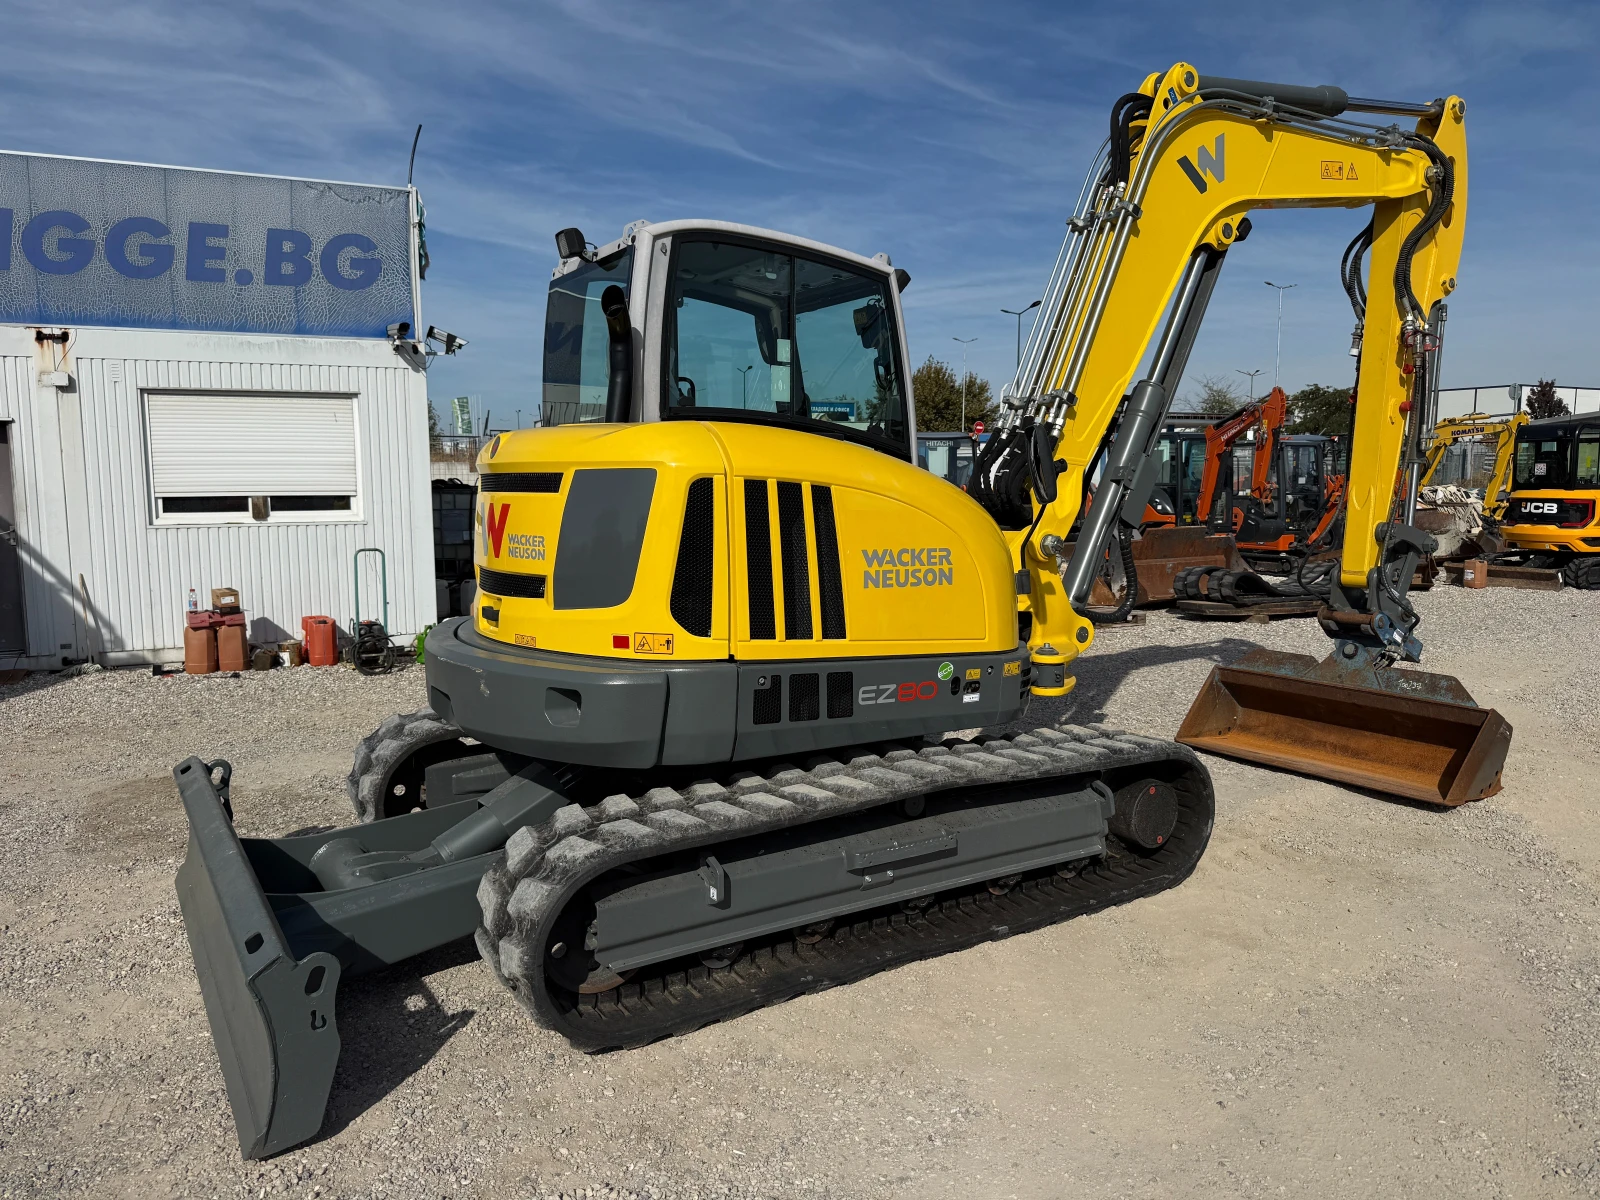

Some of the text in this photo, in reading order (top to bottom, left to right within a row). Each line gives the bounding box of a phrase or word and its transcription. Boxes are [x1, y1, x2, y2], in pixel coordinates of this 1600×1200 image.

[1451, 426, 1485, 437] KOMATSU
[1521, 501, 1558, 514] JCB
[507, 533, 546, 548] WACKER
[508, 546, 546, 561] NEUSON
[861, 547, 953, 568] WACKER
[863, 567, 953, 589] NEUSON
[858, 681, 938, 705] EZ80
